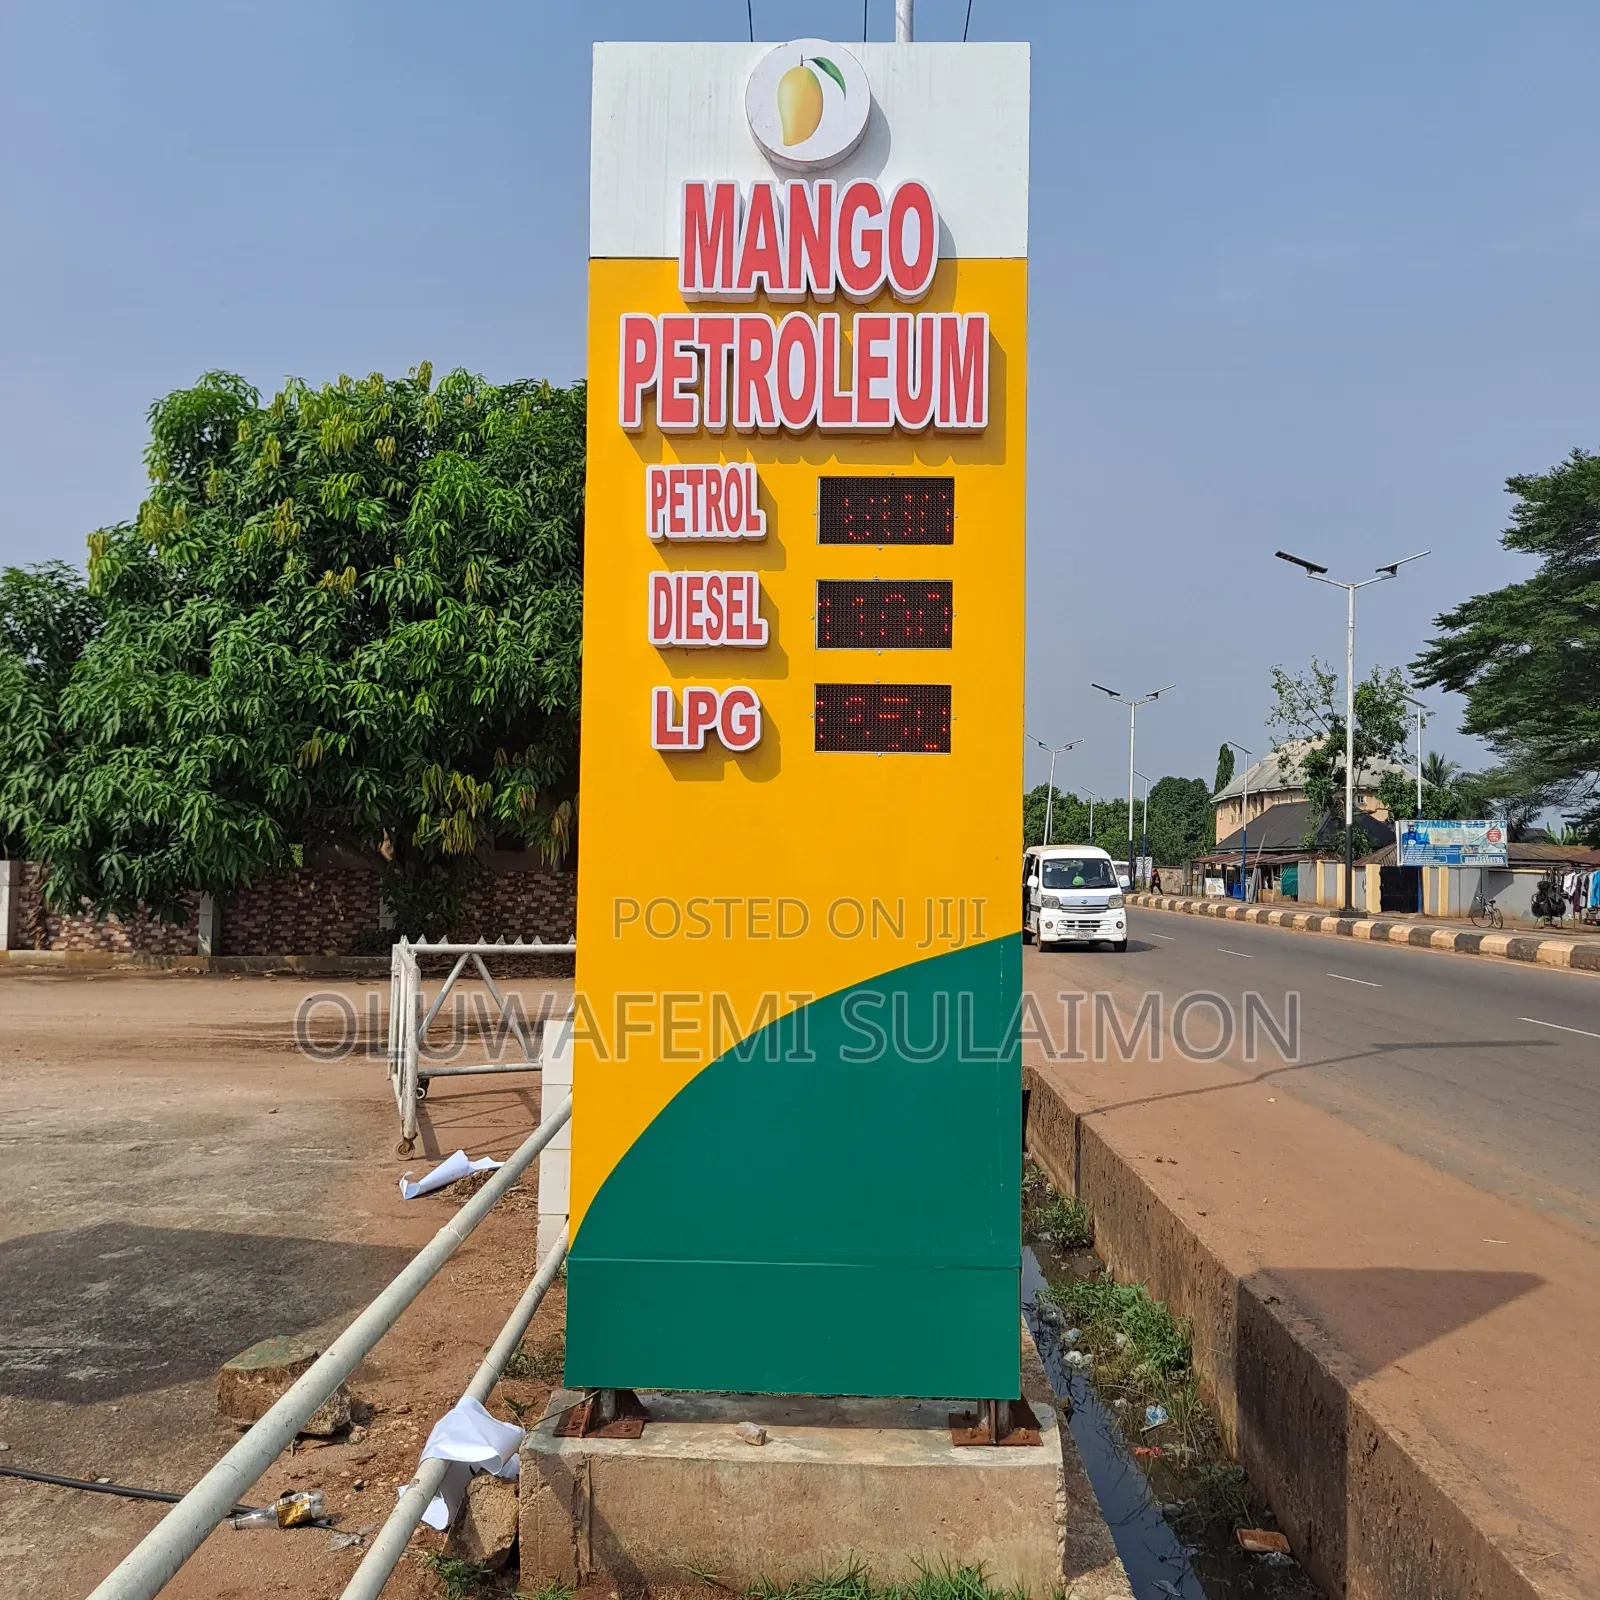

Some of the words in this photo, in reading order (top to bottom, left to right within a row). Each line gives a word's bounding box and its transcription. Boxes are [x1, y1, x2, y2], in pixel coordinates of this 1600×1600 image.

[681, 180, 936, 293] MANGO
[619, 314, 987, 427] PETROLEUM
[649, 465, 763, 535] PETROL
[651, 573, 765, 642] DIESEL
[654, 687, 758, 748] LPG
